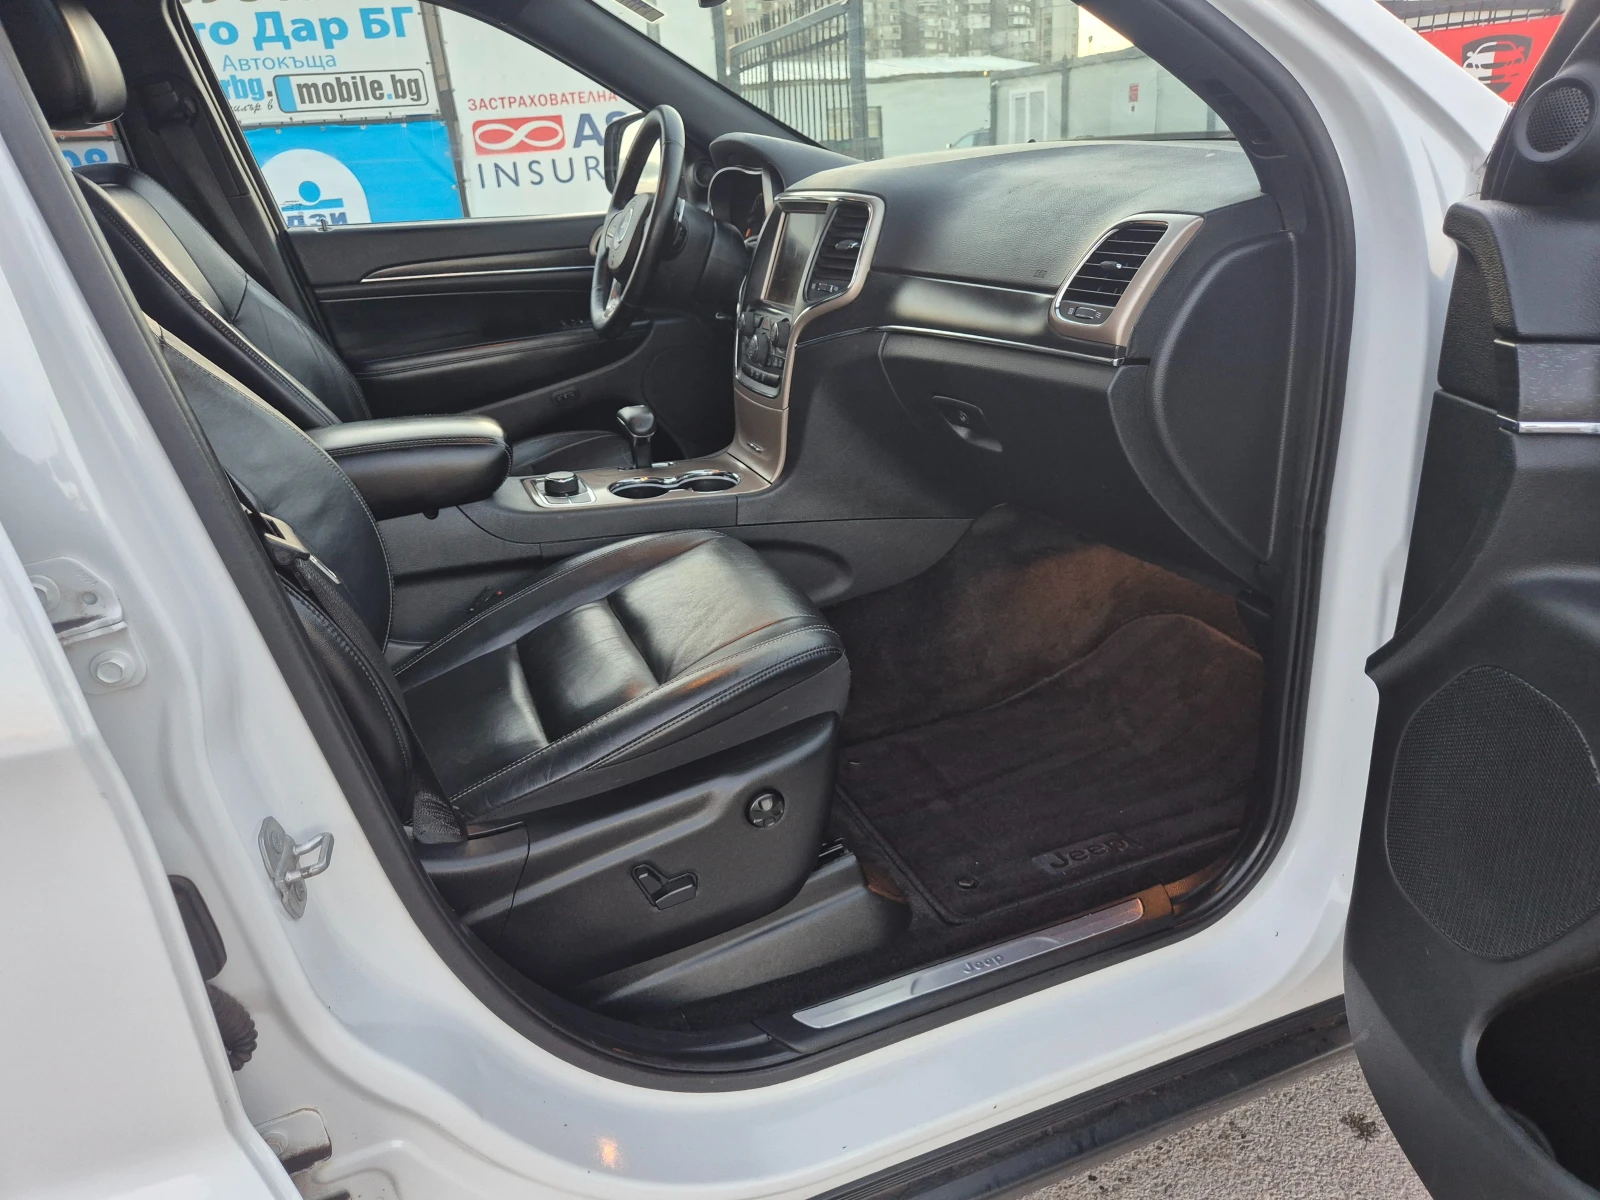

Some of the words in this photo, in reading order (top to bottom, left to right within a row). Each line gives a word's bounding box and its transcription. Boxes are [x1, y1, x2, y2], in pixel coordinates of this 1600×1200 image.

[253, 11, 349, 51] Дар
[359, 7, 414, 39] БГ
[222, 54, 337, 71] Автокъща
[296, 74, 422, 104] mobile.bg
[468, 90, 618, 111] ЗАСТРАХОВАТЕЛНА
[477, 156, 605, 189] INSUR
[1049, 840, 1129, 869] Jeep
[963, 954, 1004, 974] Jeep
